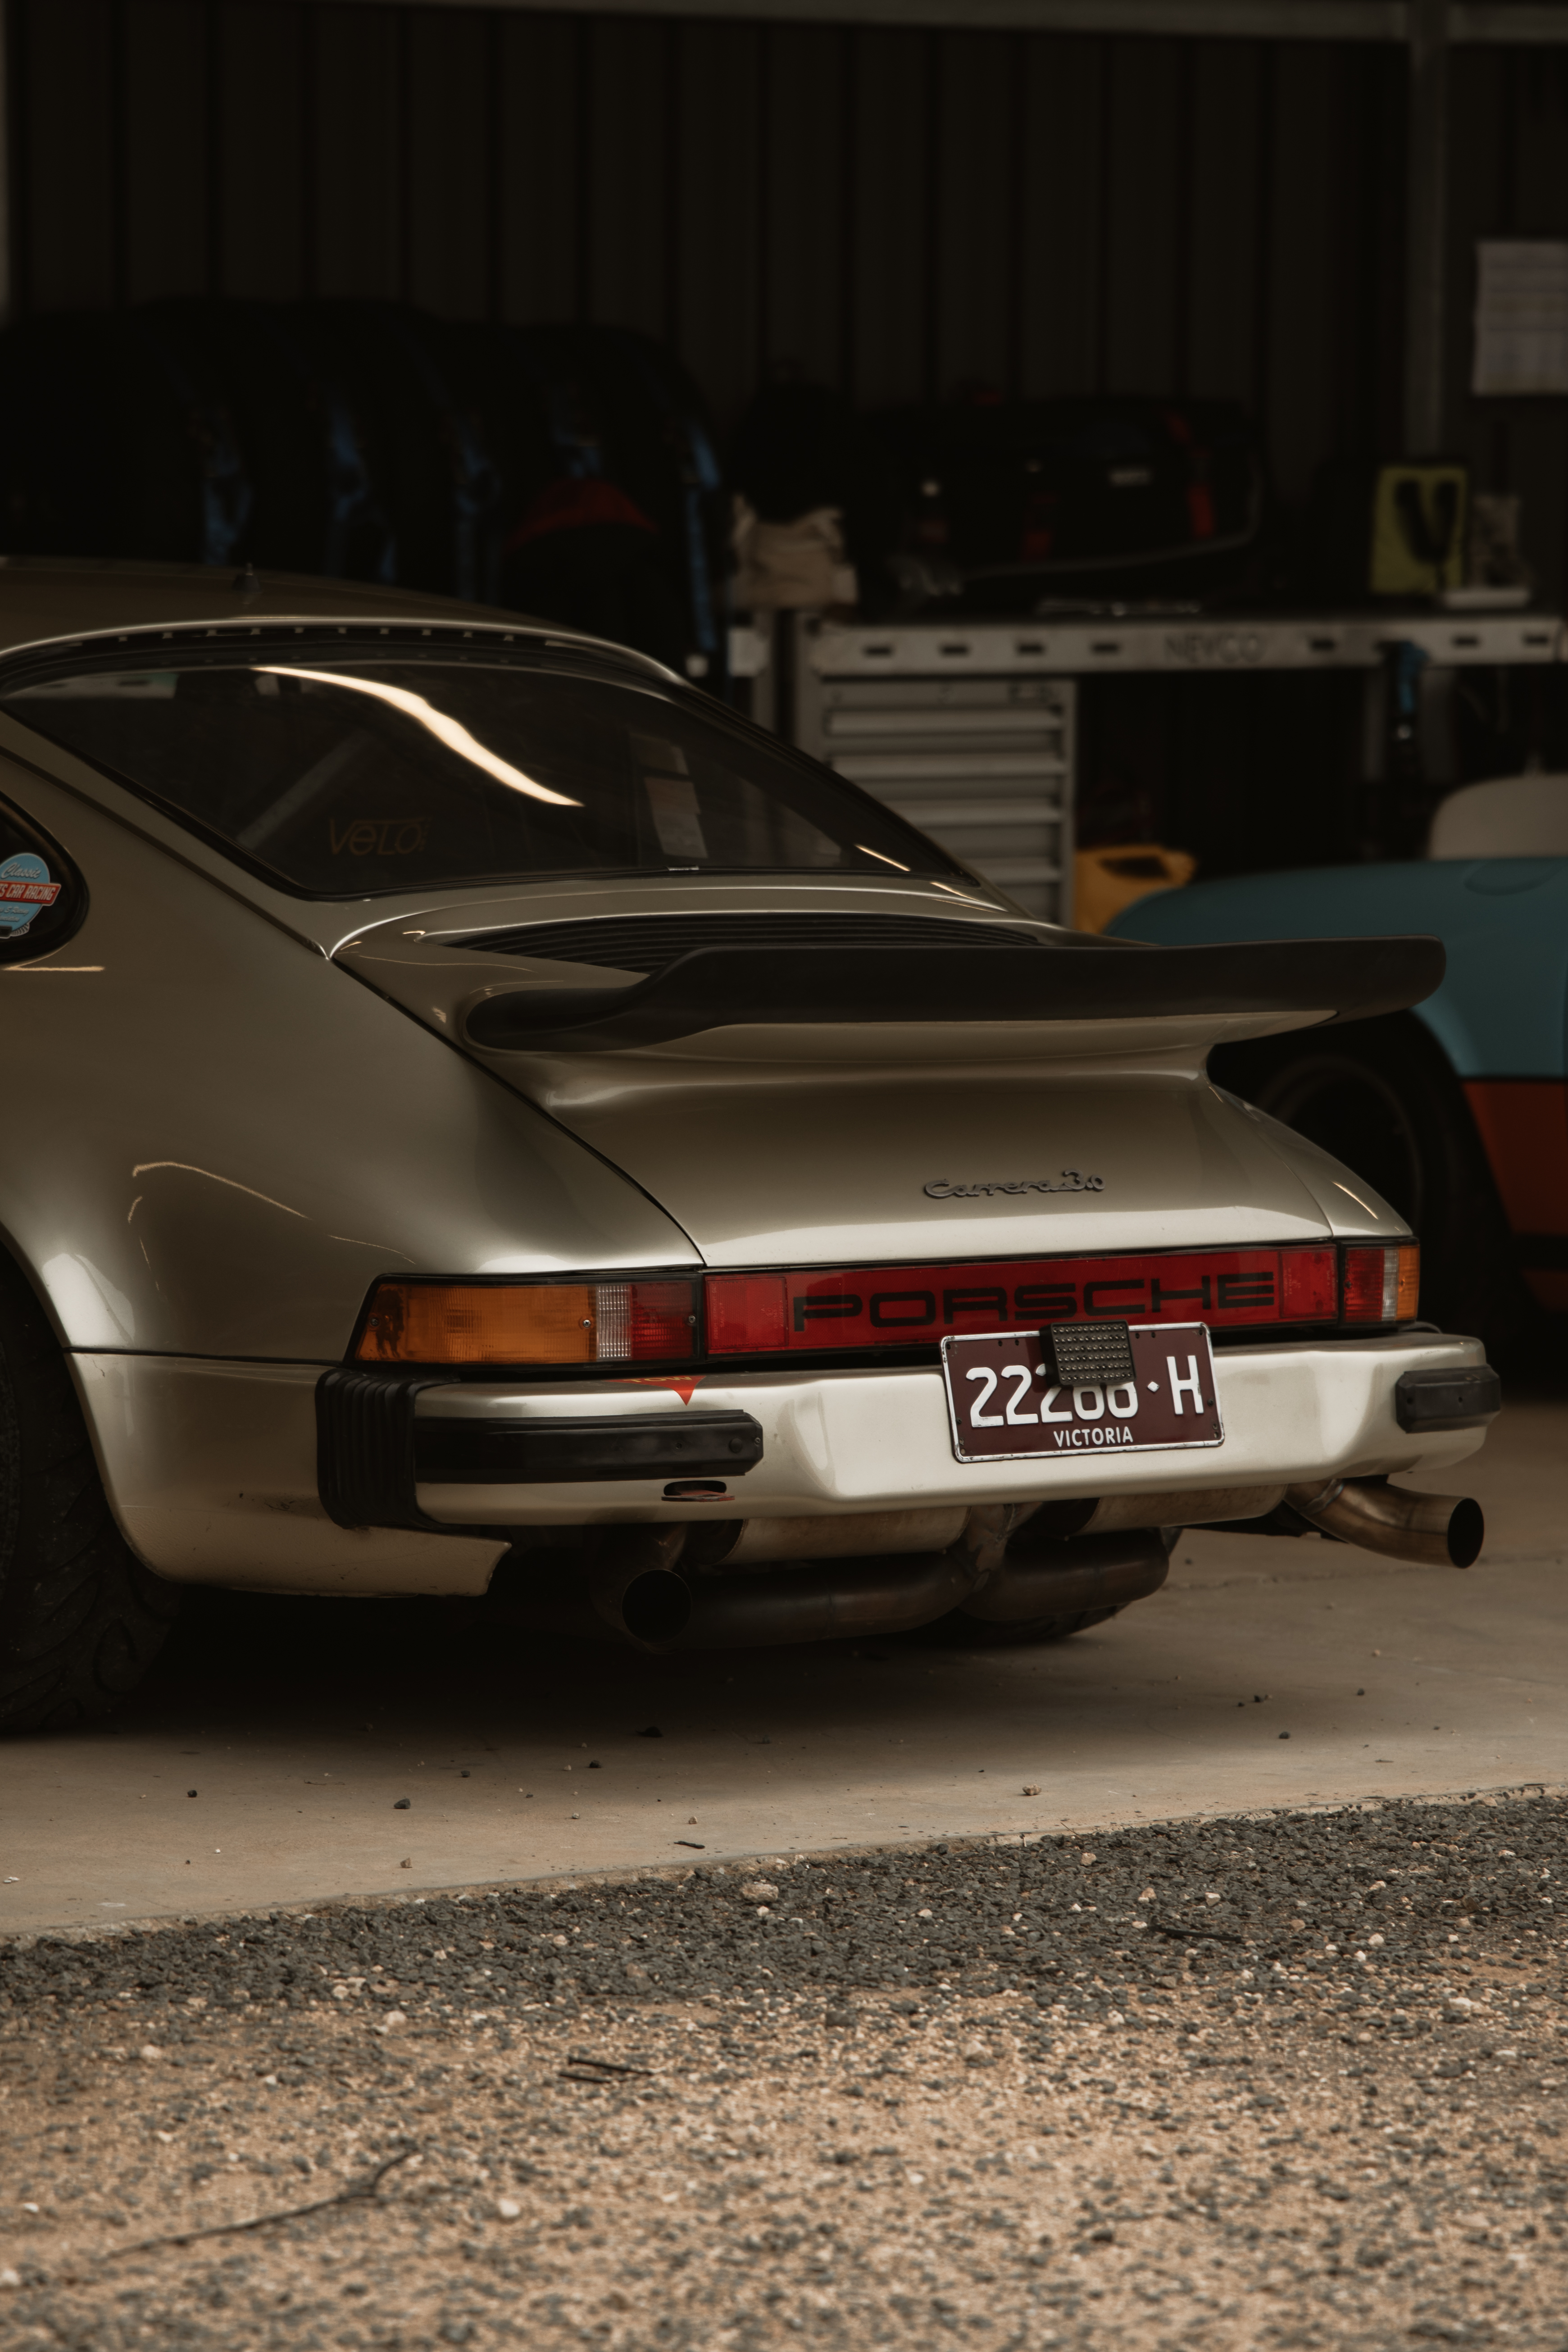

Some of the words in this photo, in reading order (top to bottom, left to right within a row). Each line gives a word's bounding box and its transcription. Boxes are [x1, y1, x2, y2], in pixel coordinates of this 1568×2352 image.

[1, 862, 41, 879] Classic
[6, 884, 26, 899] CAR
[23, 886, 56, 901] RACING
[794, 1272, 1274, 1332] PORSCHE
[1054, 1426, 1134, 1447] VICTORIA
